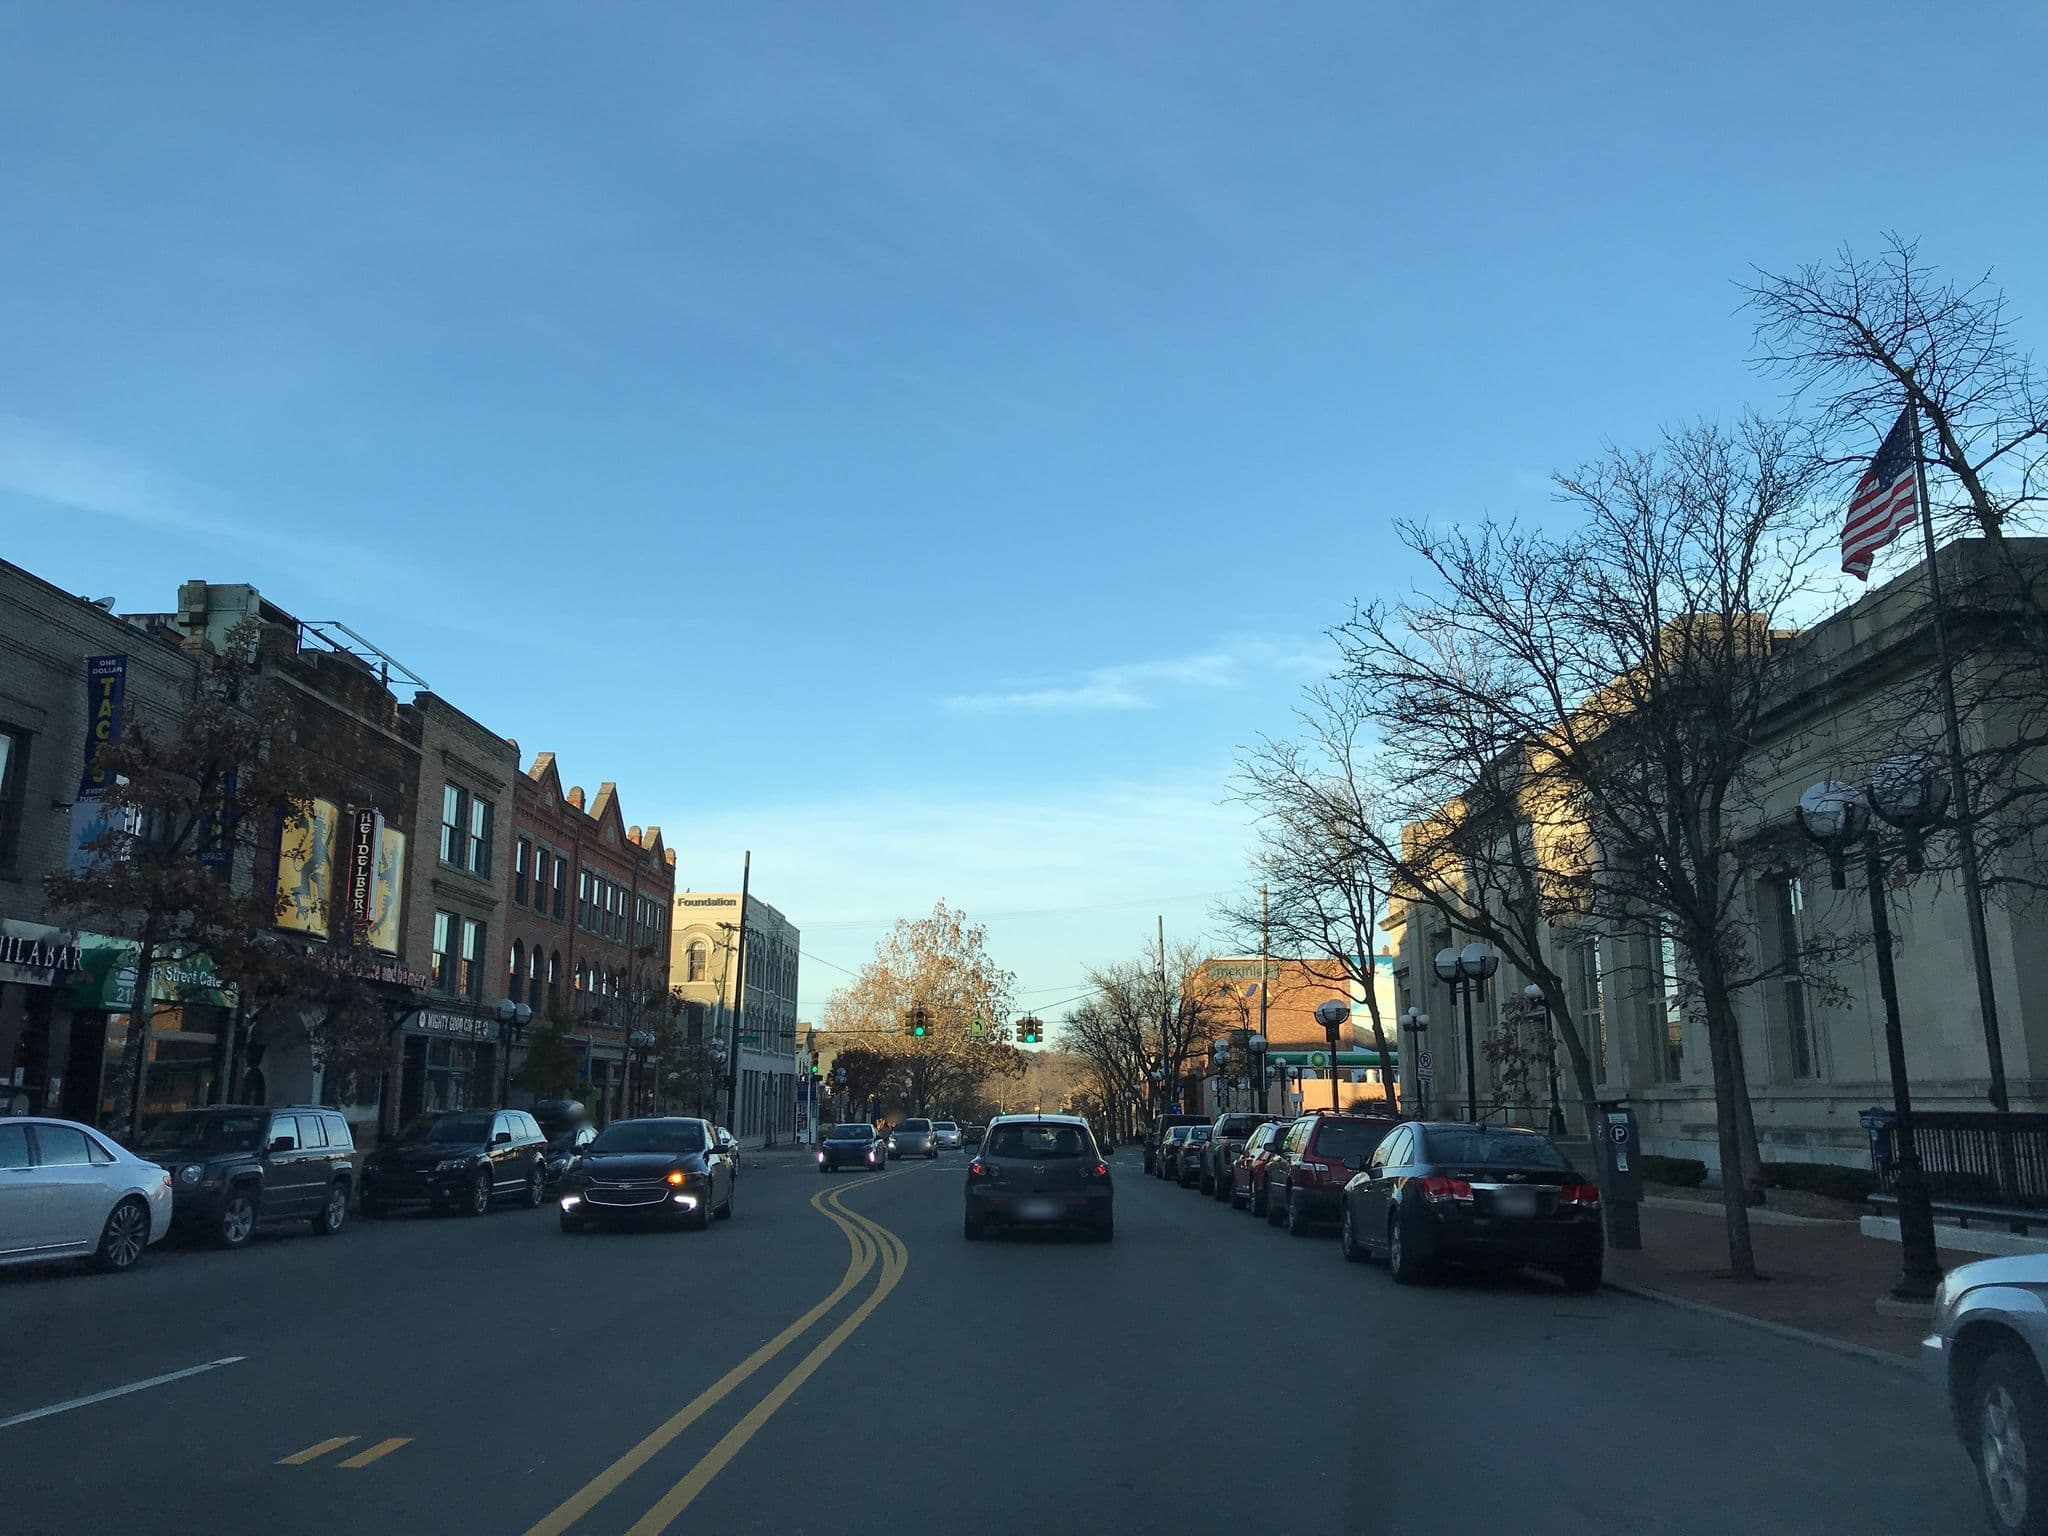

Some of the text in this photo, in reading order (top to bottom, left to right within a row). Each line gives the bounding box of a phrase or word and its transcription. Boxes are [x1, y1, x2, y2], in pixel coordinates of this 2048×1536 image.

[99, 659, 117, 667] ONE
[92, 666, 123, 675] DOLLAR
[677, 897, 737, 907] Foundation
[165, 965, 198, 984] Street
[1216, 965, 1273, 979] mckinle
